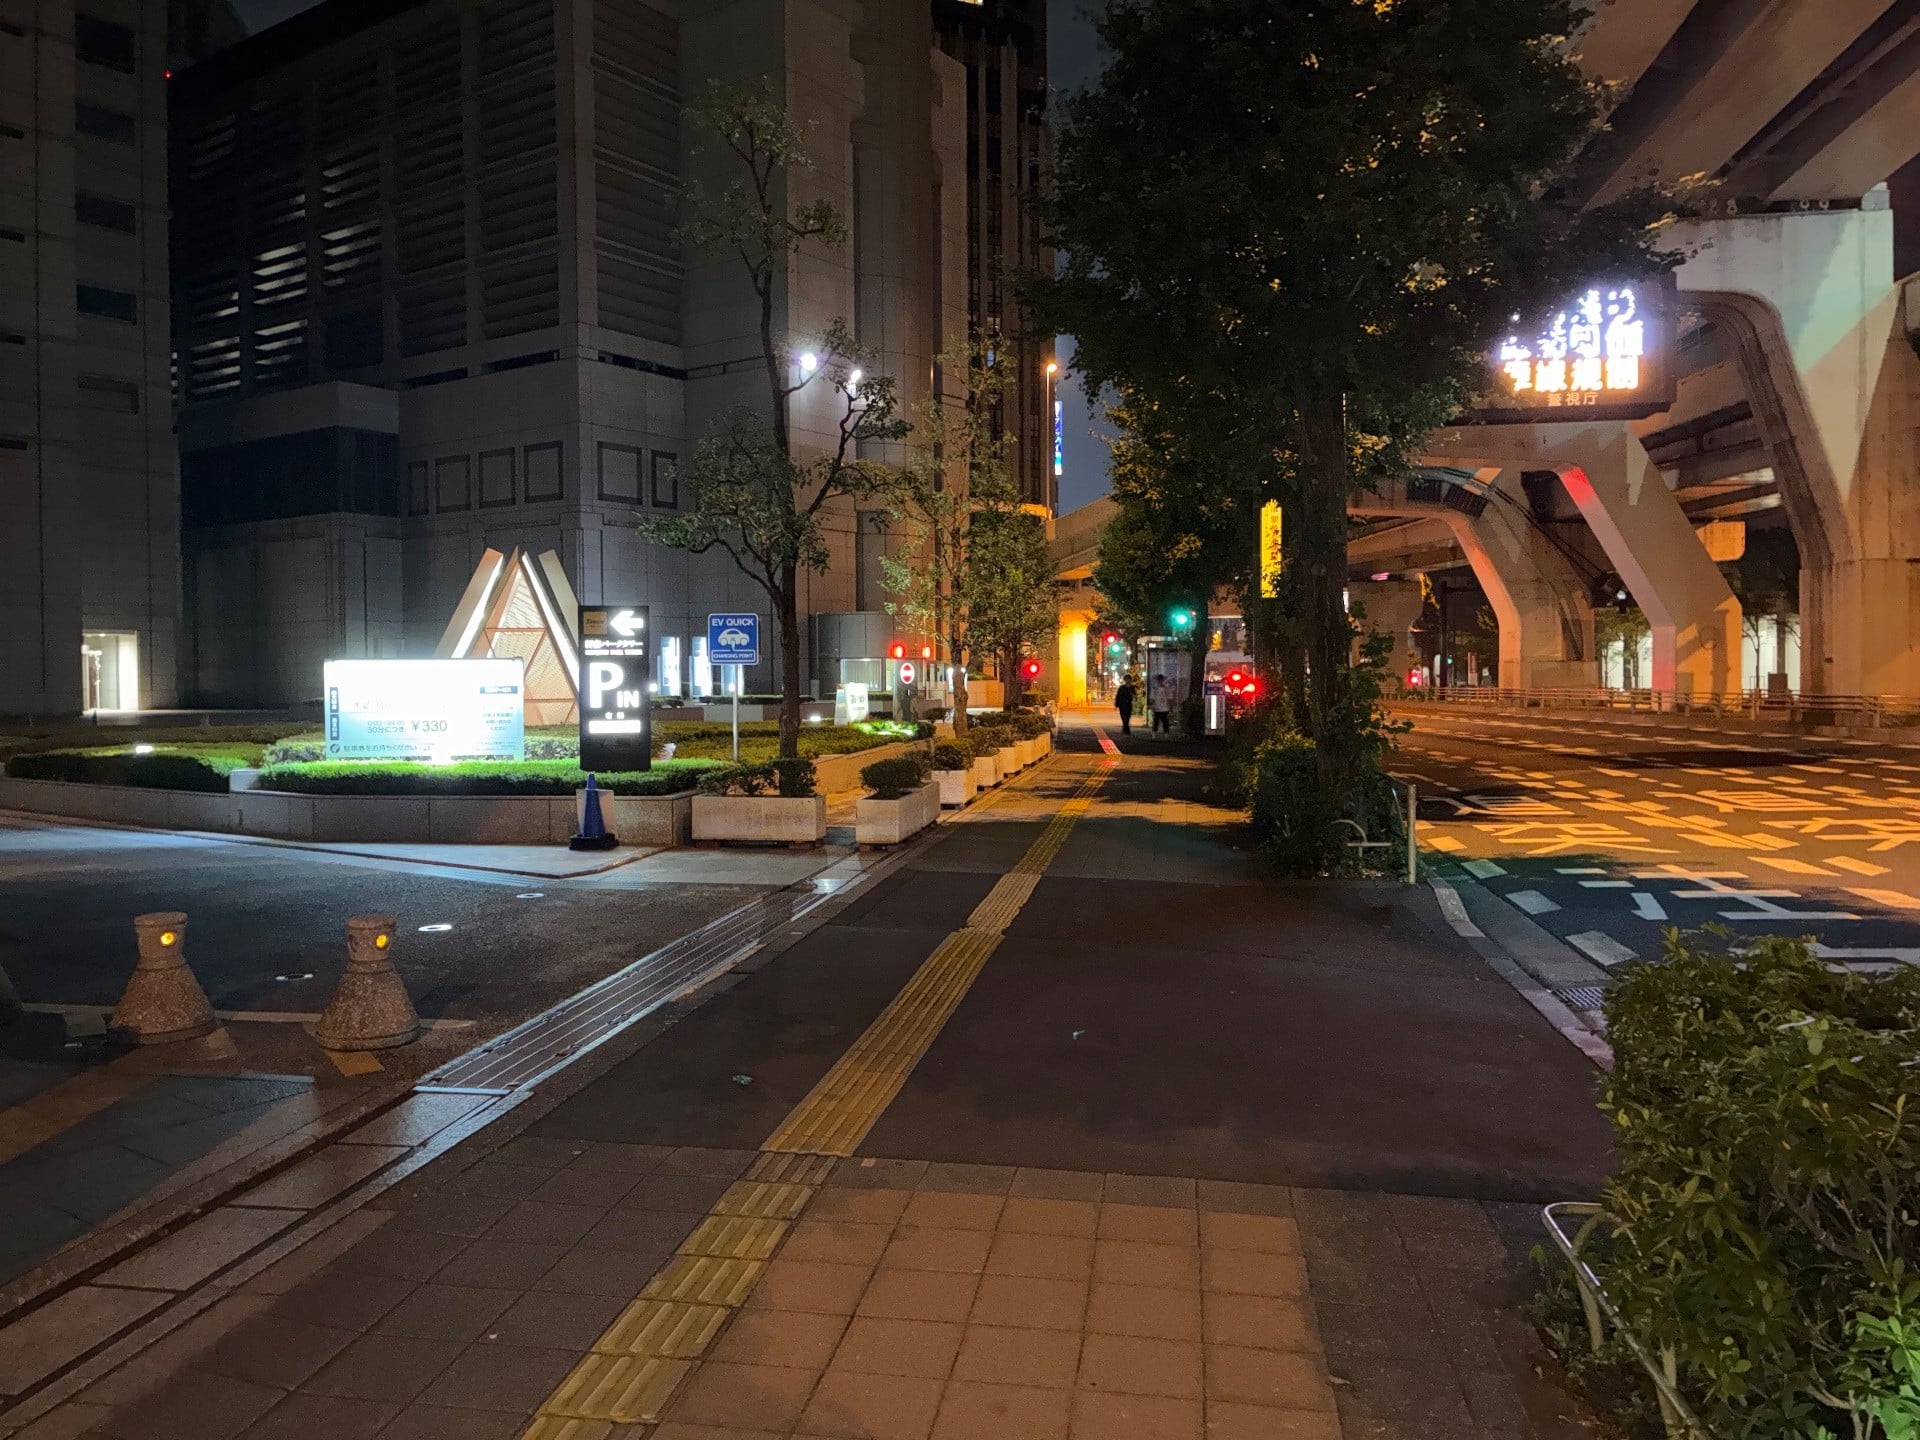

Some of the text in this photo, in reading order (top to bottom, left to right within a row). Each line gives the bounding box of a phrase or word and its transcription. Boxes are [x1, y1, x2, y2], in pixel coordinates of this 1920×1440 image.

[1547, 391, 1599, 407] 警視庁
[712, 618, 755, 627] EV QUICK
[589, 662, 640, 708] P IN
